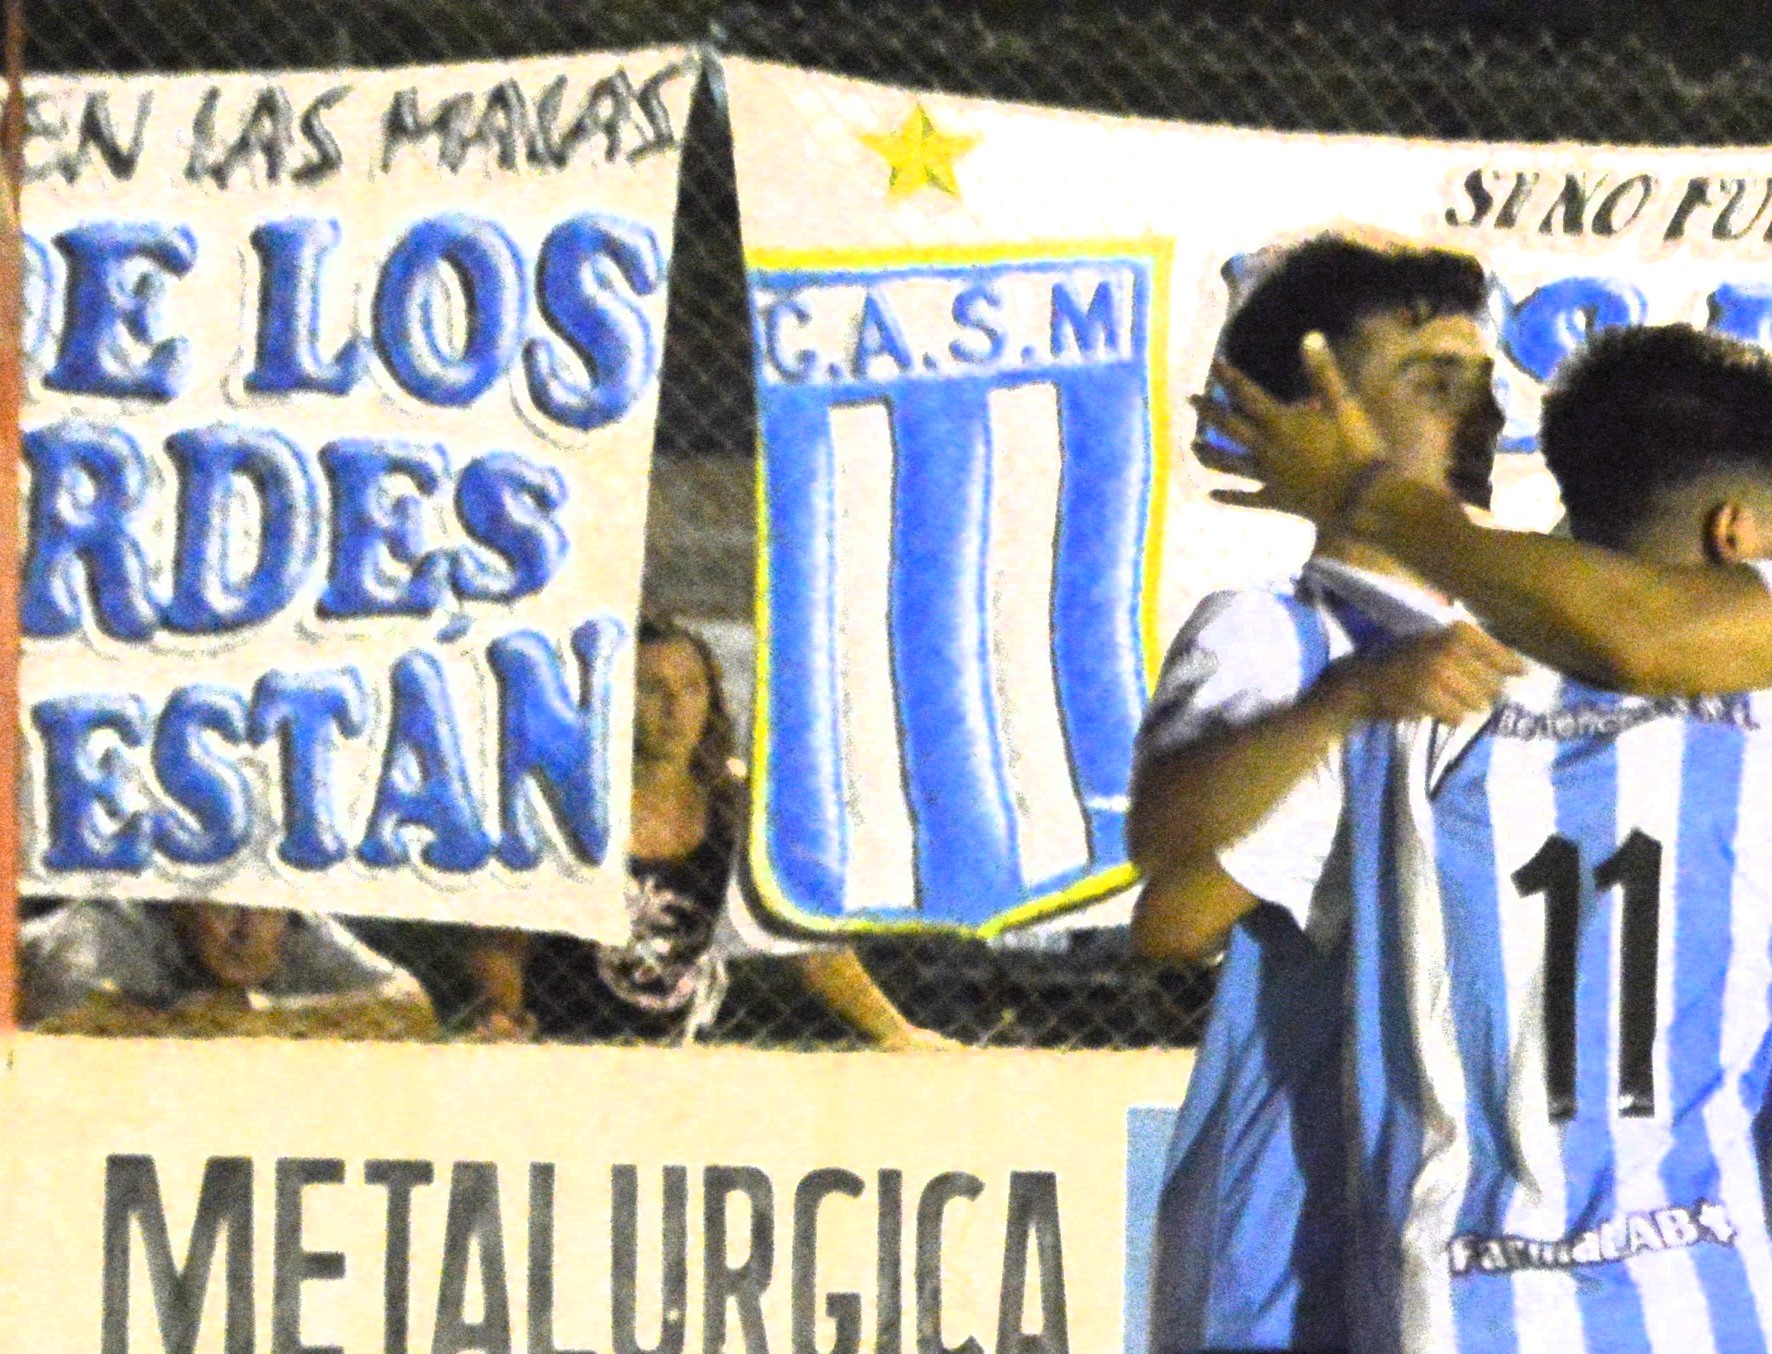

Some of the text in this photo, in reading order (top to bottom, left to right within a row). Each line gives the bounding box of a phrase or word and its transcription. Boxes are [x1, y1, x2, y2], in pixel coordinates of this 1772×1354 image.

[184, 82, 354, 190] LAS
[376, 64, 682, 176] MALAS
[1444, 168, 1540, 229] SI
[1538, 172, 1655, 238] NO
[20, 212, 665, 432] E LOS
[30, 615, 628, 874] ESTAN
[1510, 825, 1663, 1120] 11
